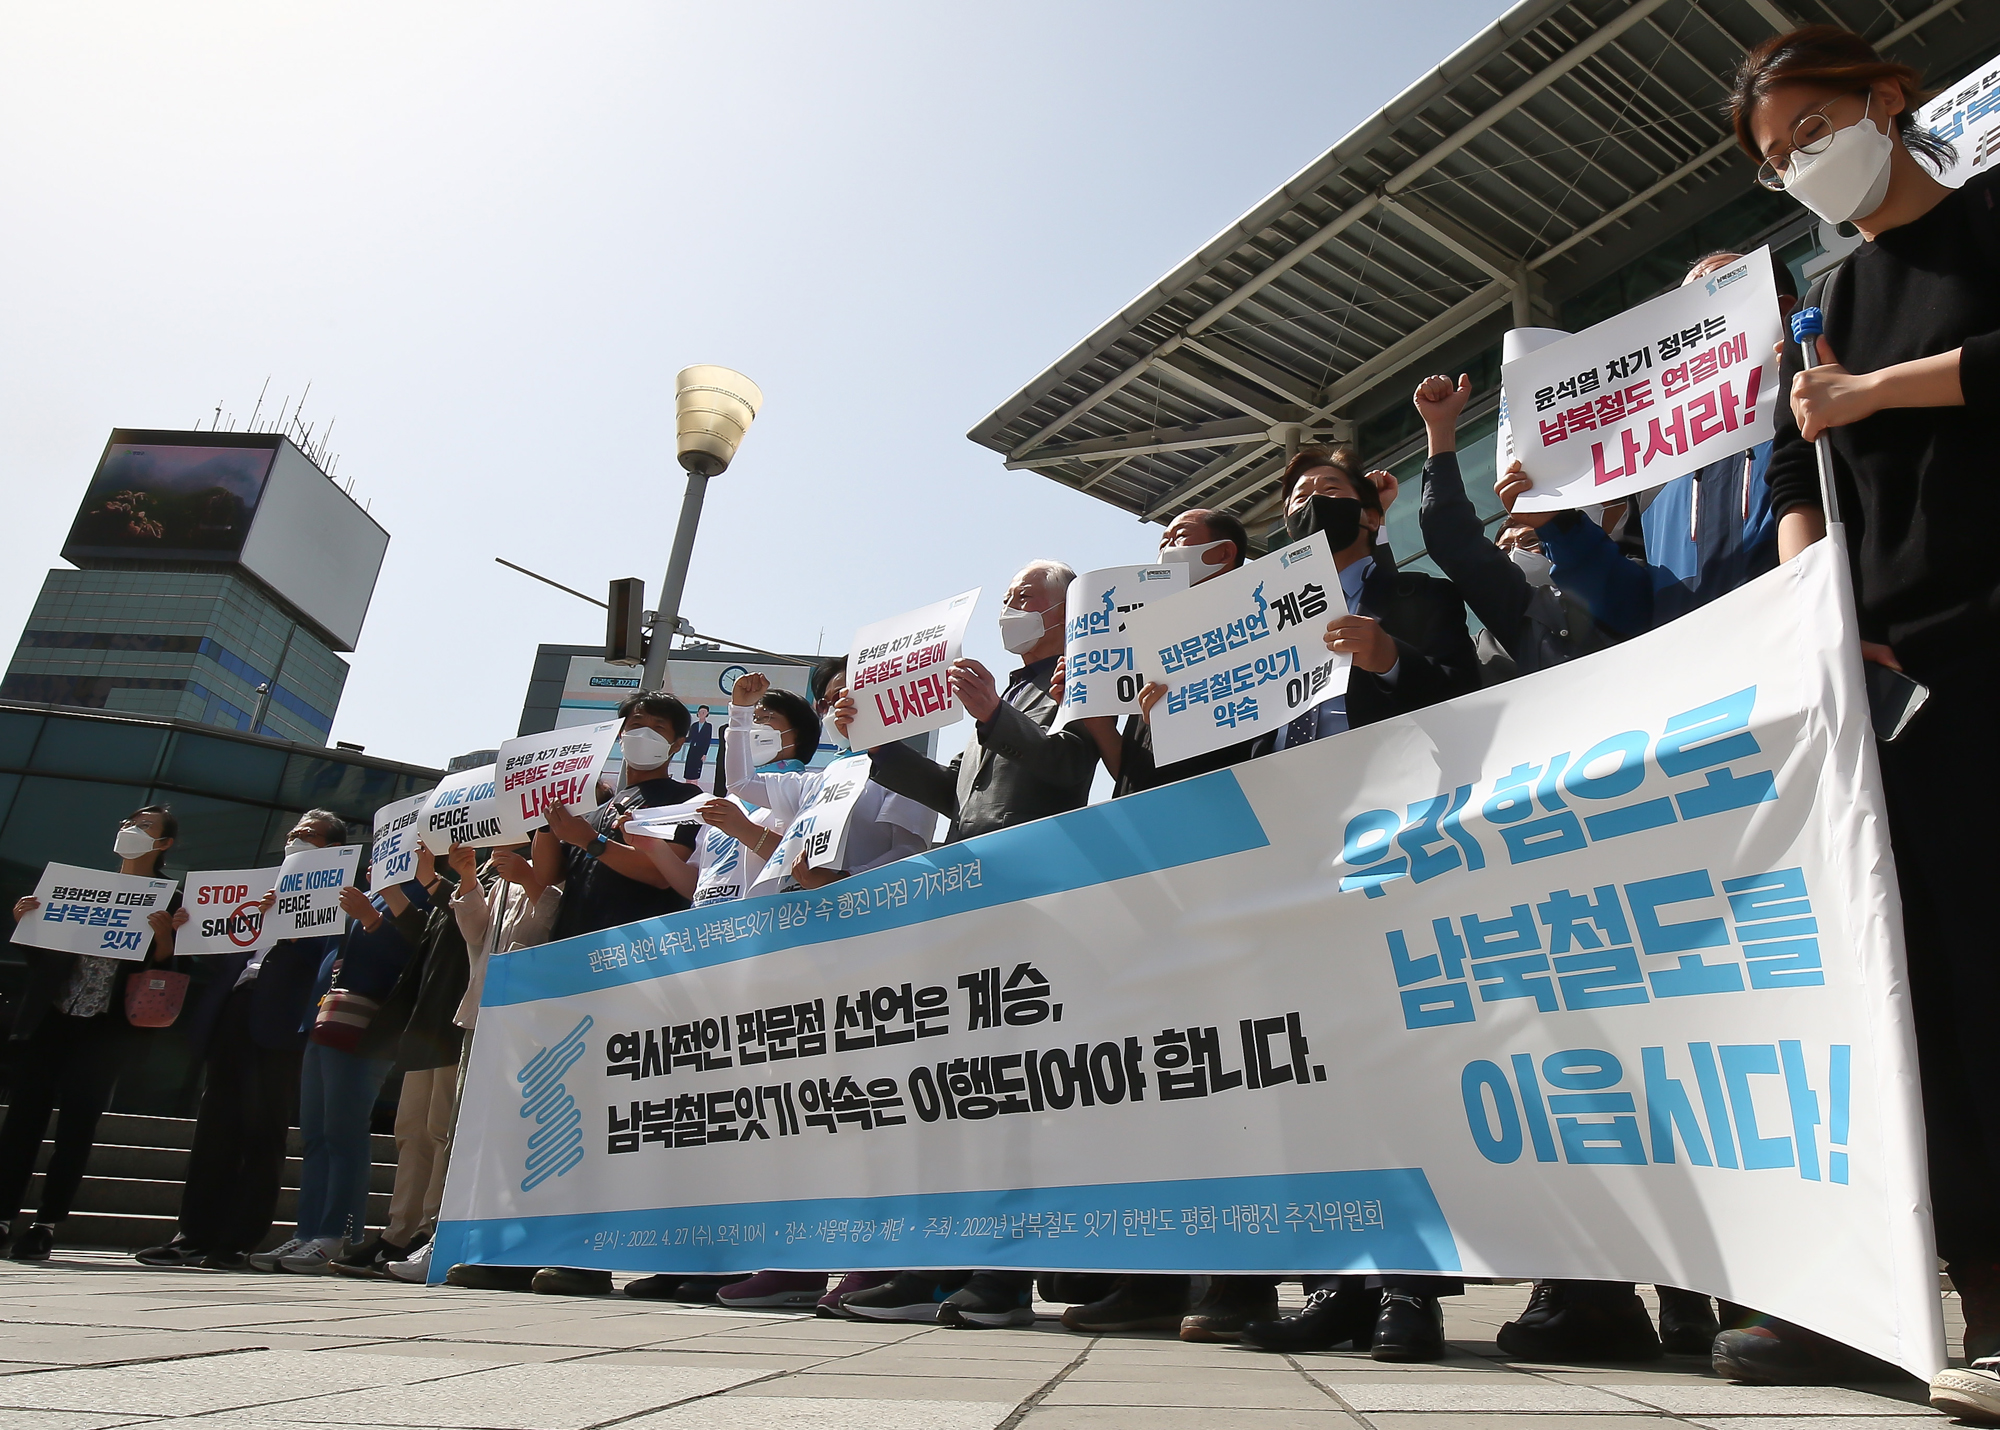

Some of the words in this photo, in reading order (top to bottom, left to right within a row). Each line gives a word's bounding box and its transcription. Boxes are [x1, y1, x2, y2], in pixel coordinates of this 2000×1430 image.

[1534, 367, 1601, 413] 윤석열
[1605, 346, 1653, 384] 차기
[1657, 314, 1728, 361] 정부는
[1538, 379, 1654, 447] 남북철도
[1661, 331, 1749, 399] 연결에
[1590, 365, 1763, 487] 나서라!
[857, 641, 889, 665] 윤석열
[889, 634, 913, 653] 차기
[912, 624, 947, 646] 정부는
[1158, 610, 1271, 675] 판문점선언
[1270, 582, 1329, 632] 계승
[853, 655, 904, 691] 남북철도
[905, 640, 948, 673] 연결에
[1166, 645, 1302, 716] 남북철도잇기
[874, 669, 954, 727] 나서라!
[1213, 696, 1260, 730] 약속
[1285, 658, 1334, 709] 이행
[504, 763, 550, 792] 남북철도
[551, 755, 595, 777] 연결에
[505, 752, 535, 771] 윤석열
[535, 748, 559, 762] 차기
[559, 743, 593, 757] 정부는
[434, 787, 467, 809] ONE
[520, 773, 591, 821] 나서라!
[1337, 783, 1487, 900] 우리
[1481, 684, 1780, 866] 힘으로
[392, 809, 420, 833] 디딤돌
[429, 806, 470, 832] PEACE
[450, 816, 501, 844] RAILWA
[804, 829, 833, 860] 이행
[279, 873, 304, 893] ONE
[305, 868, 345, 890] KOREA
[384, 851, 412, 880] 잇자
[51, 886, 113, 904] 평화번영
[115, 892, 158, 907] 디딤돌
[197, 885, 249, 905] STOP
[278, 894, 311, 915] PEACE
[43, 902, 133, 928] 남북철도
[295, 906, 339, 930] RAILWAY
[588, 946, 627, 974] 판문점
[630, 937, 657, 964] 선언
[659, 928, 697, 957] 4주년,
[695, 908, 776, 951] 남북철도잇기
[778, 903, 811, 930] 일상
[814, 899, 835, 922] 속
[837, 890, 873, 917] 행진
[875, 877, 910, 909] 다짐
[911, 859, 984, 902] 기자회견
[100, 930, 143, 951] 잇자
[1385, 866, 1826, 1031] 남북철도를
[606, 1014, 734, 1082] 역사적인
[735, 998, 828, 1067] 판문점
[834, 982, 951, 1054] 선언은
[957, 961, 1064, 1032] 계승,
[607, 1081, 801, 1155] 남북철도잇기
[798, 1075, 908, 1135] 약속은
[908, 1035, 1148, 1124] 이행되어야
[1152, 1010, 1328, 1102] 합니다.
[1460, 1039, 1852, 1186] 이읍시다!
[593, 1230, 620, 1250] 일시
[627, 1230, 658, 1247] 2022.
[661, 1229, 671, 1246] 4.
[674, 1228, 689, 1245] 27
[716, 1223, 740, 1246] 오전
[743, 1222, 766, 1244] 10시
[815, 1218, 850, 1243] 서울역
[878, 1217, 905, 1242] 계단
[961, 1213, 1008, 1239] 2022년
[1011, 1210, 1079, 1239] 남북철도
[1084, 1207, 1118, 1239] 잇기
[1122, 1207, 1177, 1237] 한반도
[1181, 1204, 1218, 1236] 평화
[1222, 1203, 1281, 1236] 대행진
[1284, 1199, 1386, 1234] 추진위원회
